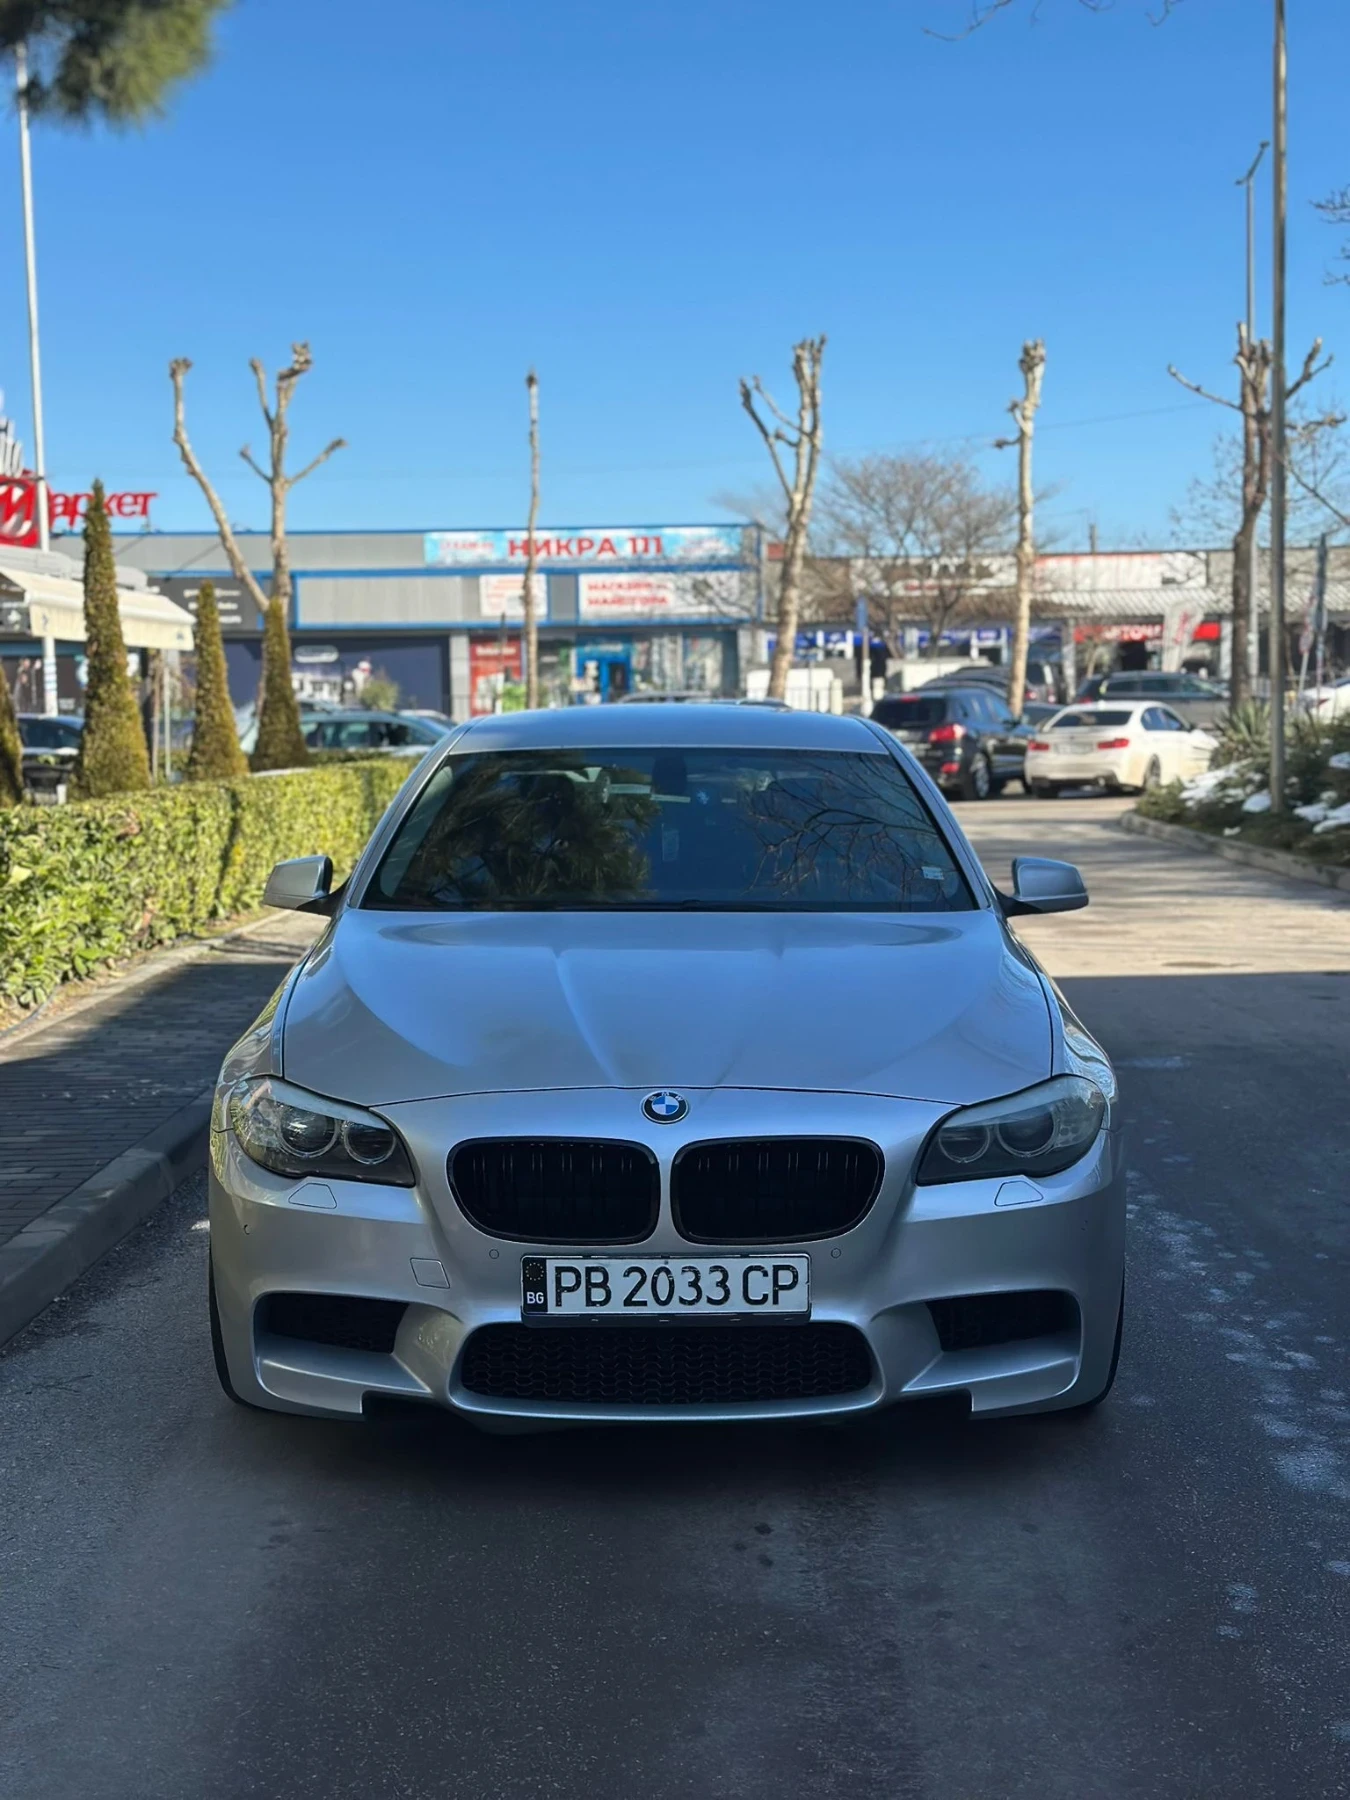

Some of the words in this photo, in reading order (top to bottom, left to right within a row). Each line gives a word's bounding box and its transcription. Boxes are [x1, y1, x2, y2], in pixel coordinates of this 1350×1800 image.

[507, 536, 617, 558] НИКРА
[554, 1265, 612, 1307] PB
[622, 1264, 731, 1307] 2033
[742, 1264, 799, 1306] CP
[526, 1292, 545, 1305] BG
